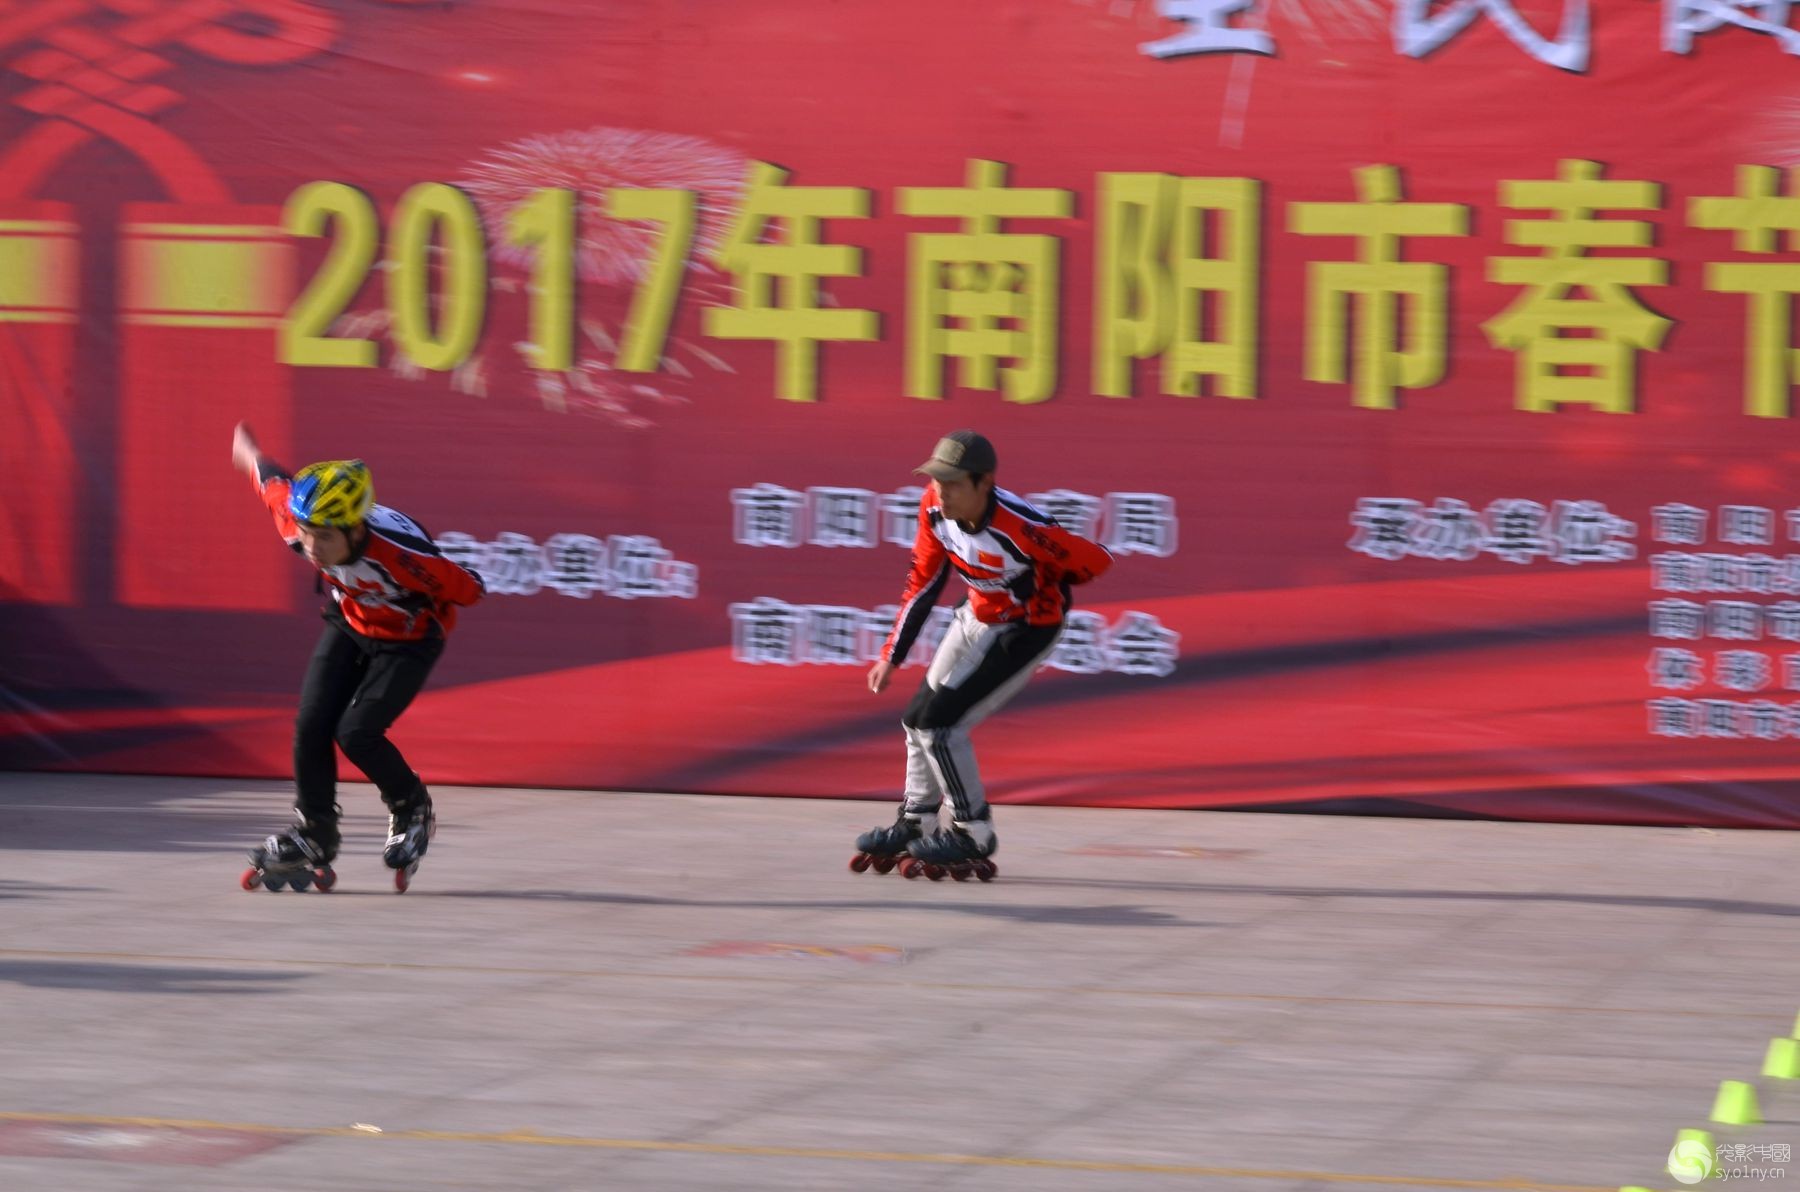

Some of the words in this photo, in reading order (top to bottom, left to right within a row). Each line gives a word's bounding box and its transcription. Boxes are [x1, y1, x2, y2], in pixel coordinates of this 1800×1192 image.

[730, 482, 1179, 557] 南阳市育局
[1650, 502, 1800, 545] 南阳
